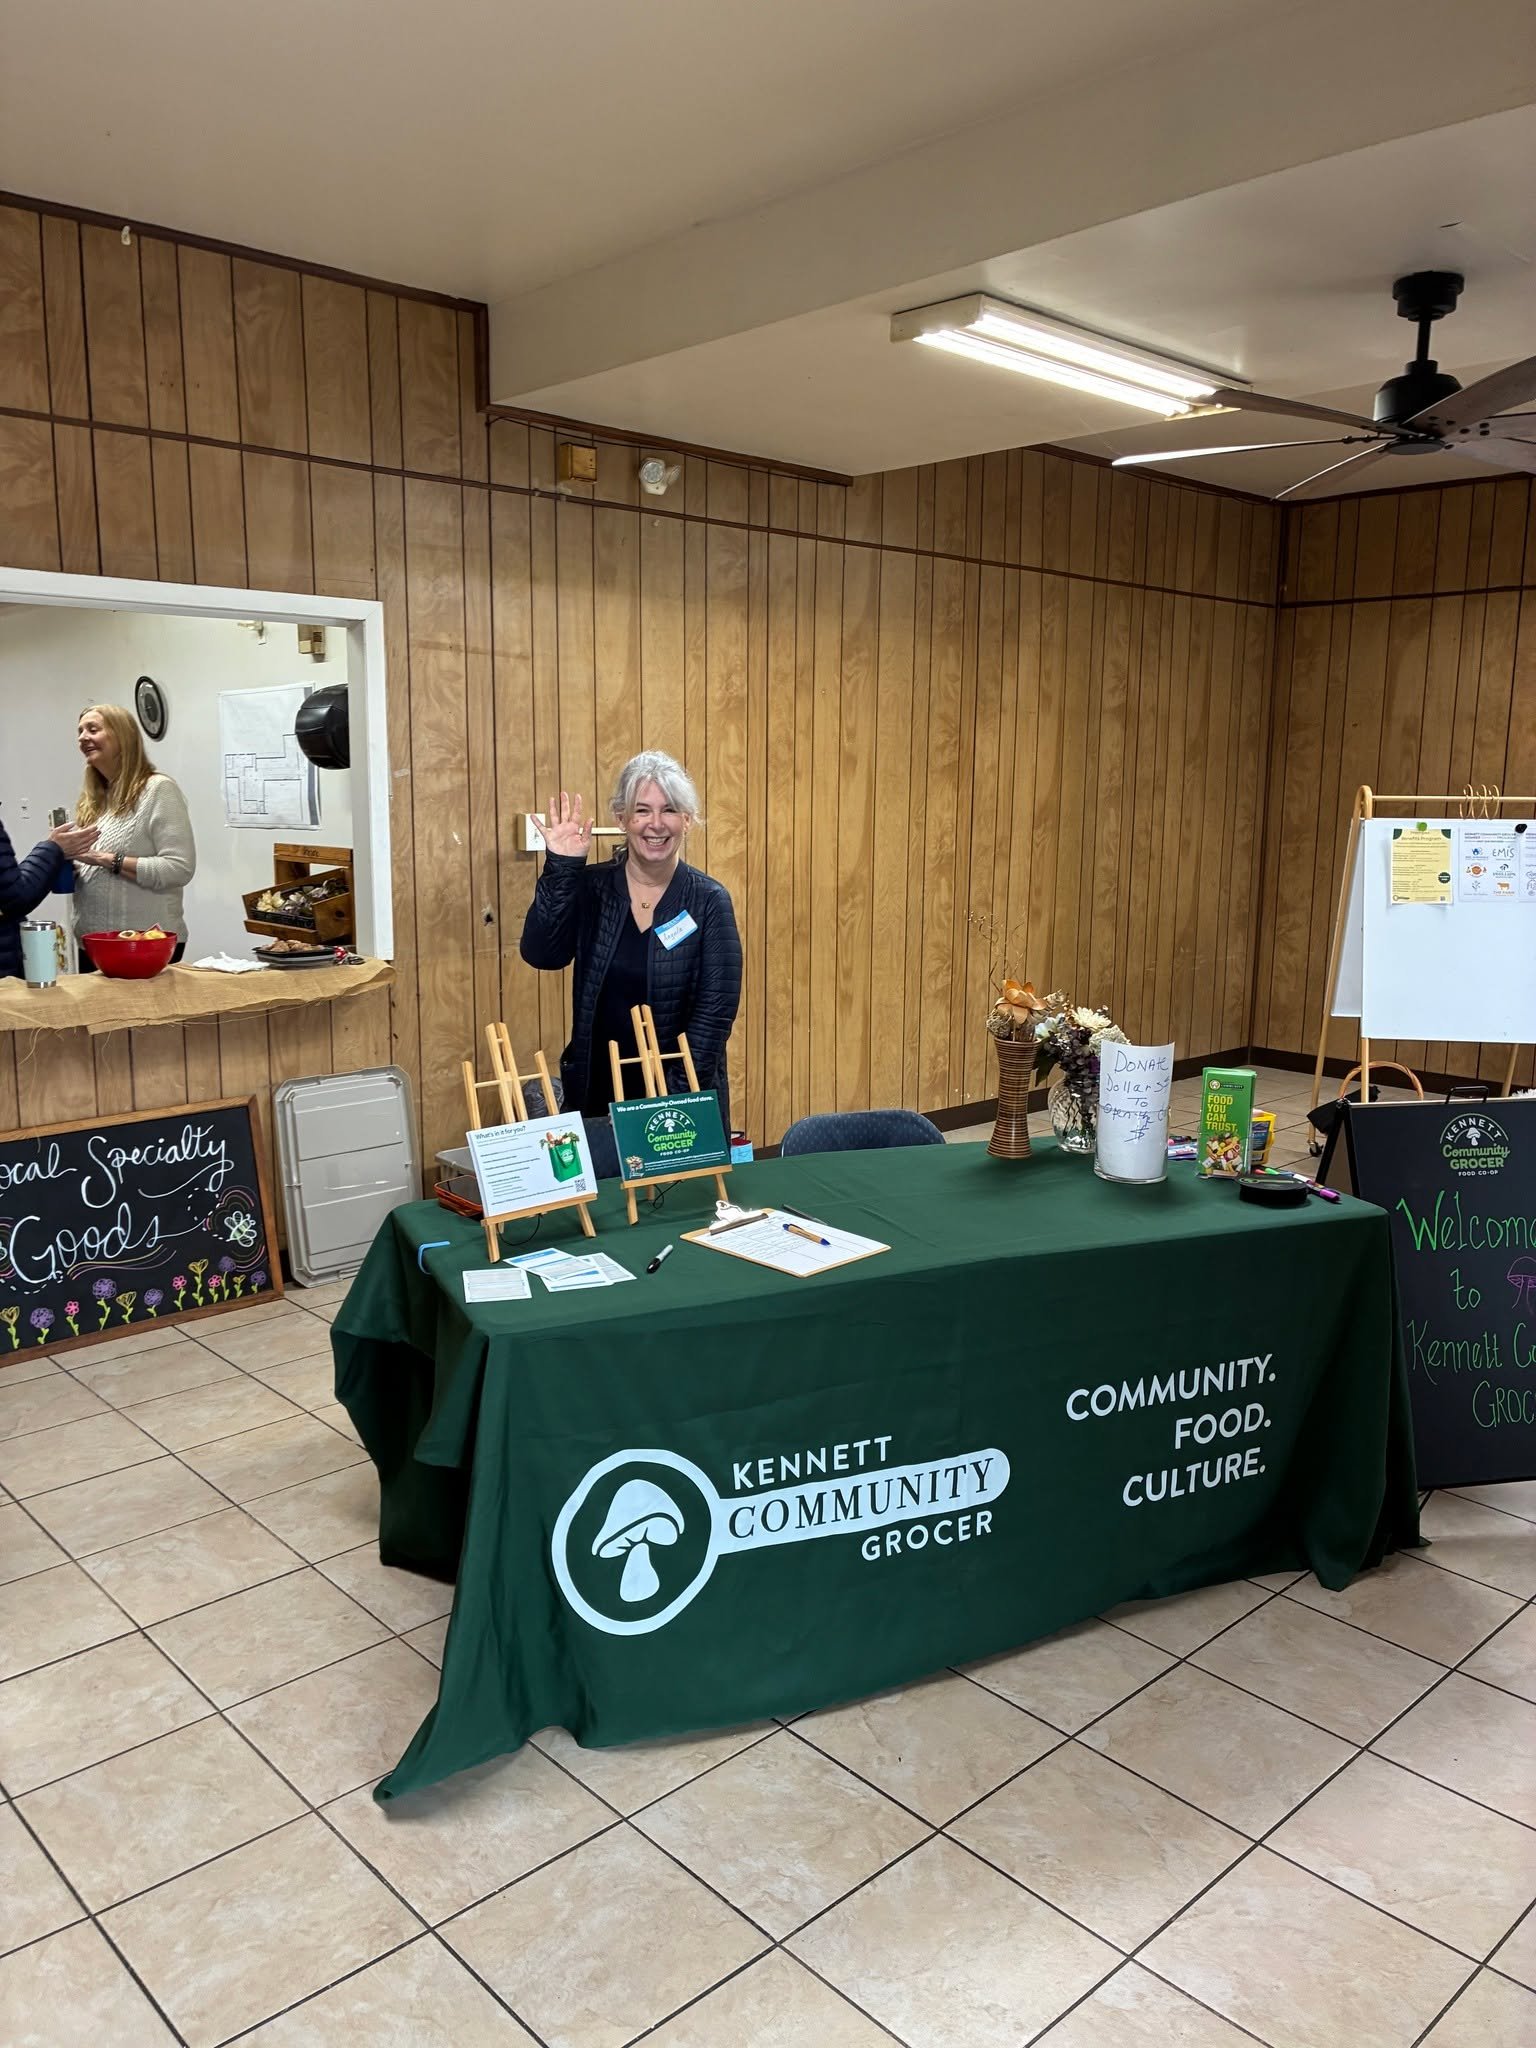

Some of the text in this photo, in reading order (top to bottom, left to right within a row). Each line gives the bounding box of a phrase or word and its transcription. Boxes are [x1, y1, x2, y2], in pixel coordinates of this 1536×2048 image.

[1127, 1097, 1148, 1107] To
[1207, 1104, 1226, 1113] YOU
[1208, 1094, 1233, 1105] FOOD
[513, 1125, 526, 1134] you?
[648, 1111, 690, 1131] KENNETT
[1207, 1113, 1226, 1122] CAN
[1445, 1117, 1502, 1141] KENNETT
[647, 1128, 697, 1143] Community
[653, 1139, 693, 1152] GROCER
[1443, 1143, 1510, 1158] Community
[0, 1124, 234, 1208] ocal Specialty
[1450, 1157, 1504, 1170] GROCER
[10, 1203, 205, 1284] Goods
[1450, 1268, 1480, 1310] to
[1407, 1320, 1502, 1386] Kennett
[1066, 1353, 1277, 1421] COMMUNITY.
[1174, 1402, 1272, 1450] FOOD.
[733, 1435, 893, 1490] KENNETT
[1122, 1447, 1266, 1507] CULTURE.
[728, 1457, 995, 1539] COMMUNITY
[861, 1510, 993, 1562] GROCER
